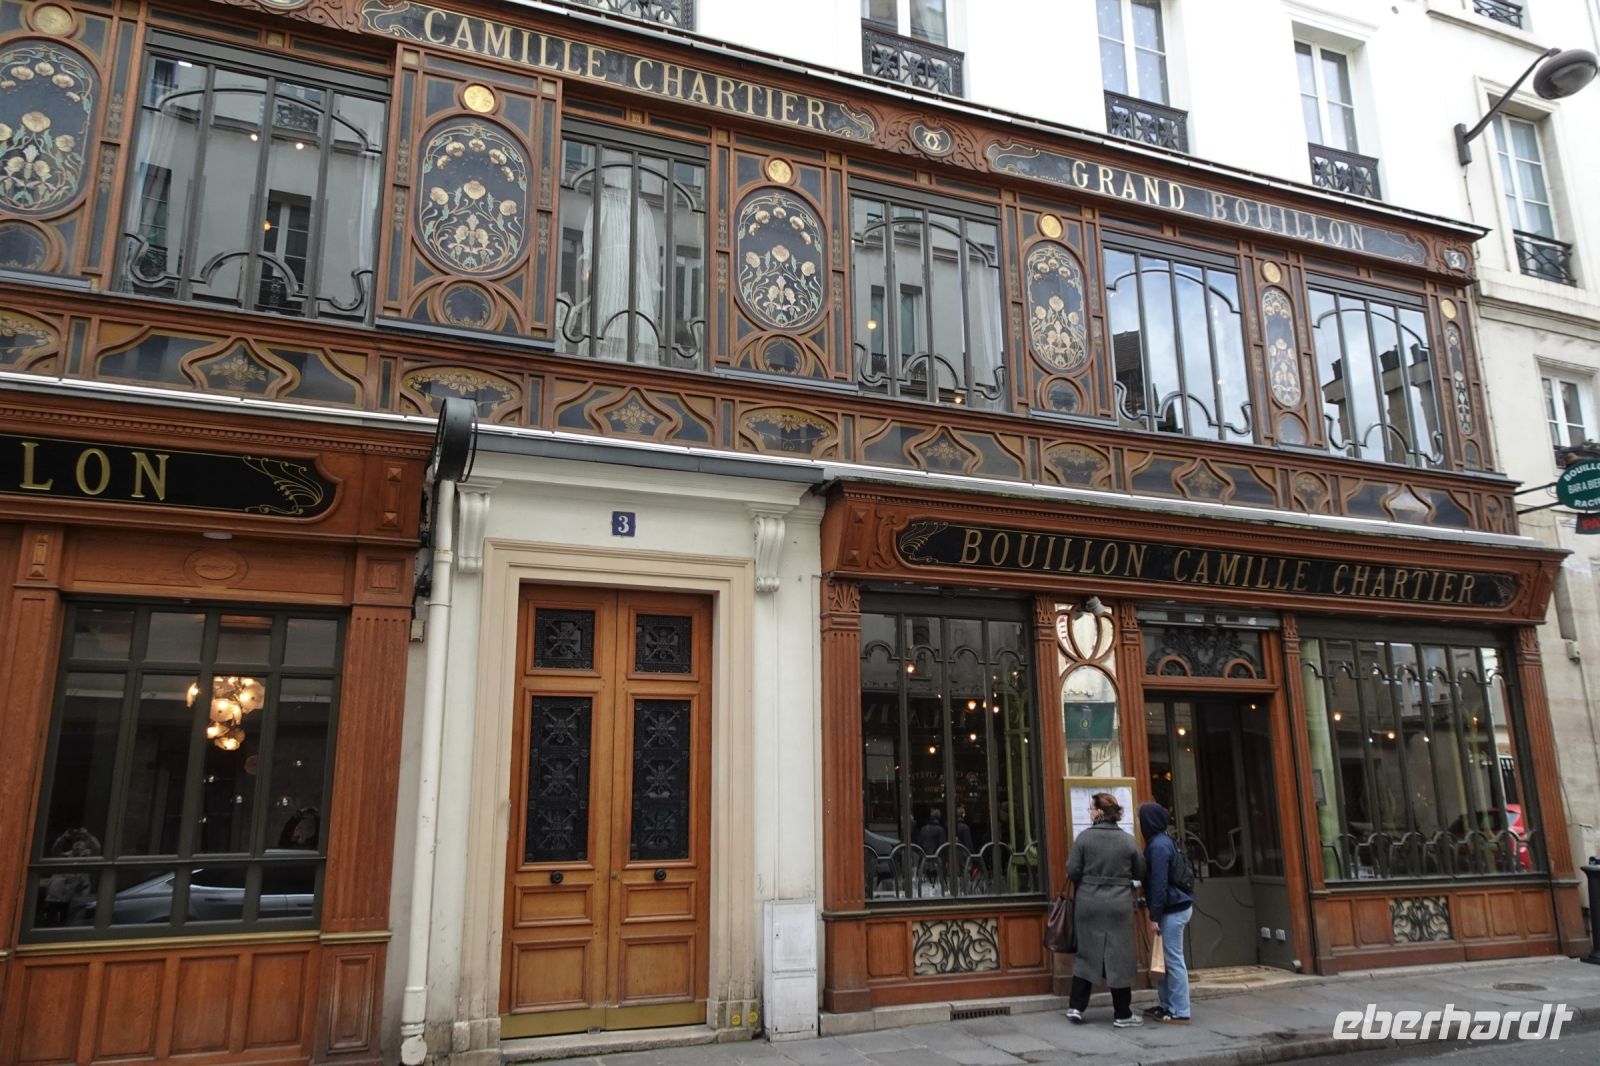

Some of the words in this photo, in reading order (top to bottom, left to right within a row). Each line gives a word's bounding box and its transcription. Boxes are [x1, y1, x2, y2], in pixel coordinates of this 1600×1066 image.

[424, 9, 606, 81] CAMILLE
[633, 58, 827, 129] CHARTIER
[1072, 160, 1185, 211] GRAND
[1209, 192, 1365, 250] BOUILLON
[1450, 252, 1460, 268] 3
[19, 442, 170, 500] LON
[618, 515, 630, 533] 3
[959, 528, 1148, 578] BOUILLON
[1173, 548, 1311, 592] CAMILLE
[1332, 563, 1475, 604] CHARTIER
